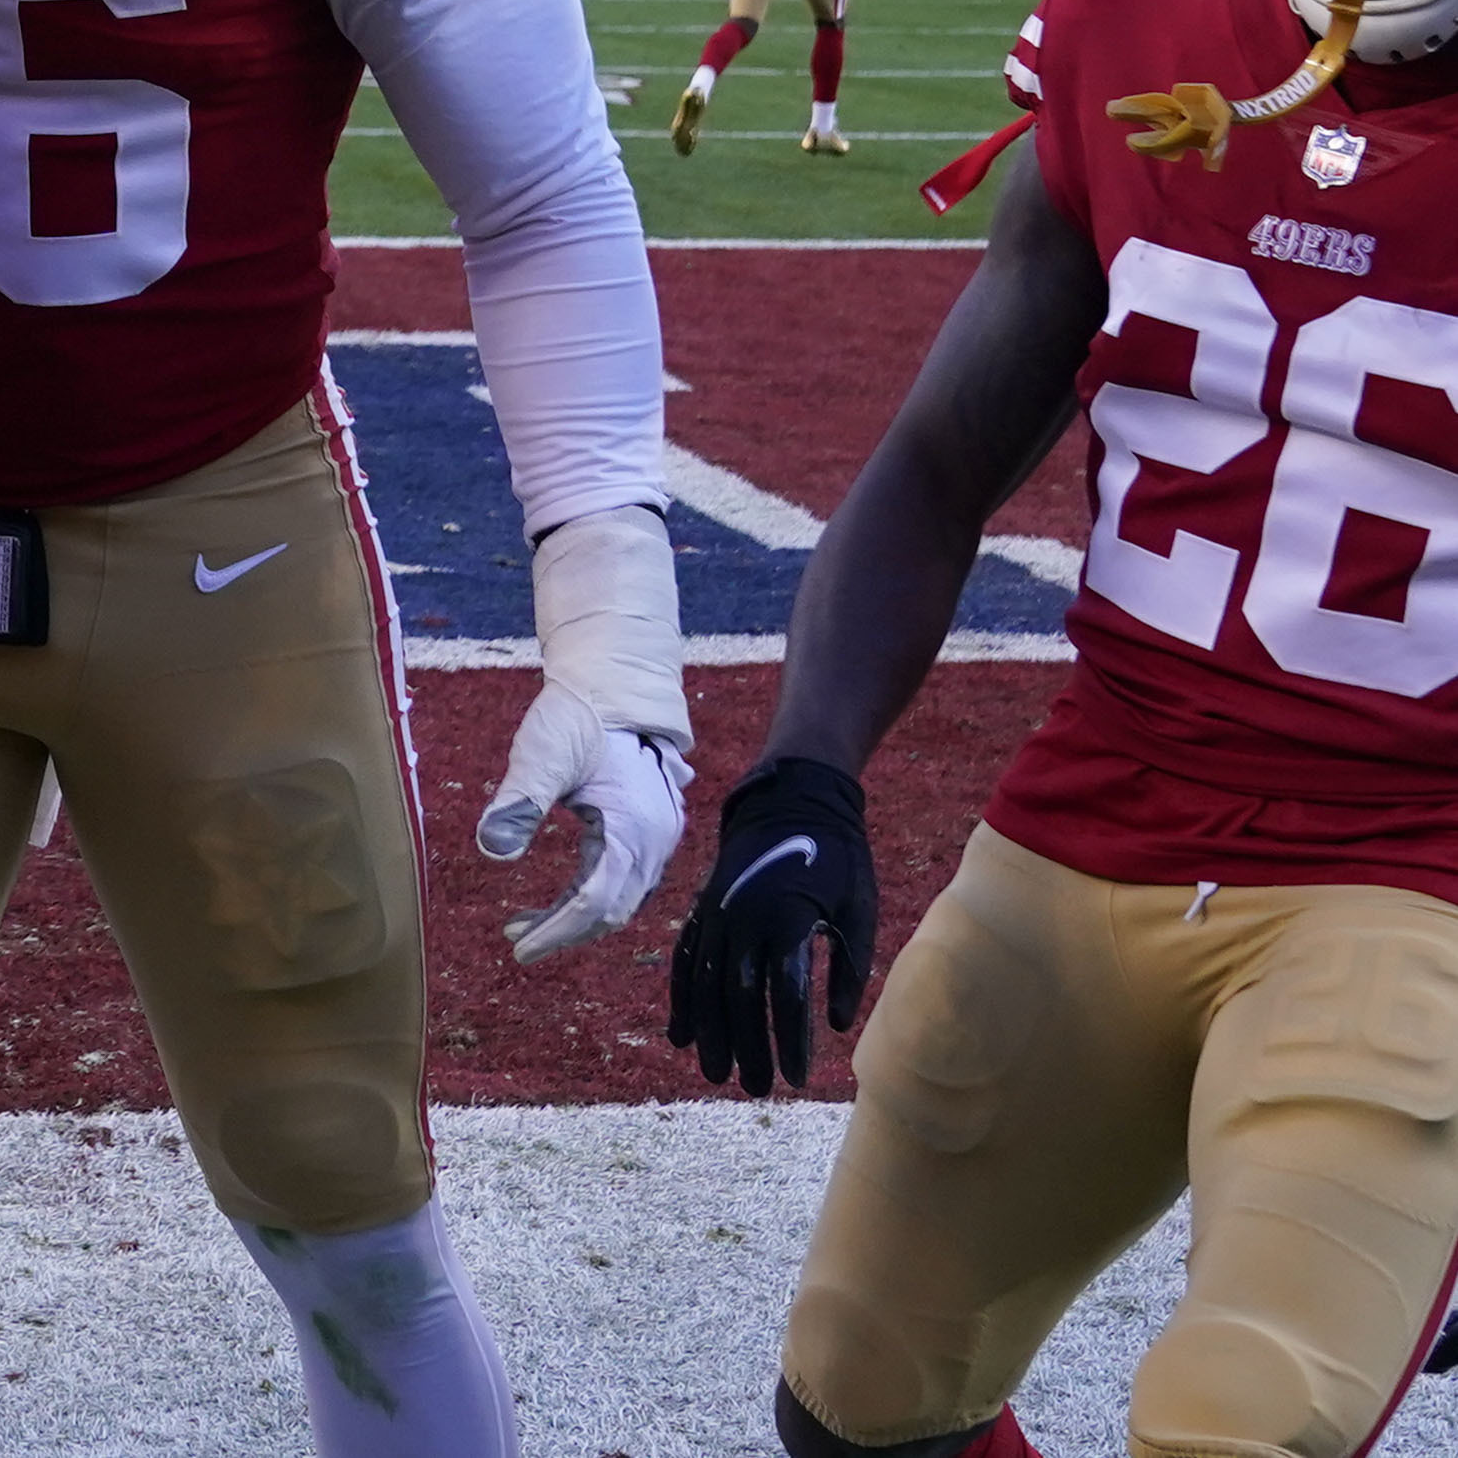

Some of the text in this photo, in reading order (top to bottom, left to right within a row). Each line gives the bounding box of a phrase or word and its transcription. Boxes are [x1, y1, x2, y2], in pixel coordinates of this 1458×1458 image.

[1233, 69, 1318, 120] NXTRND
[1248, 214, 1376, 276] 49ERS
[1083, 235, 1458, 699] 26
